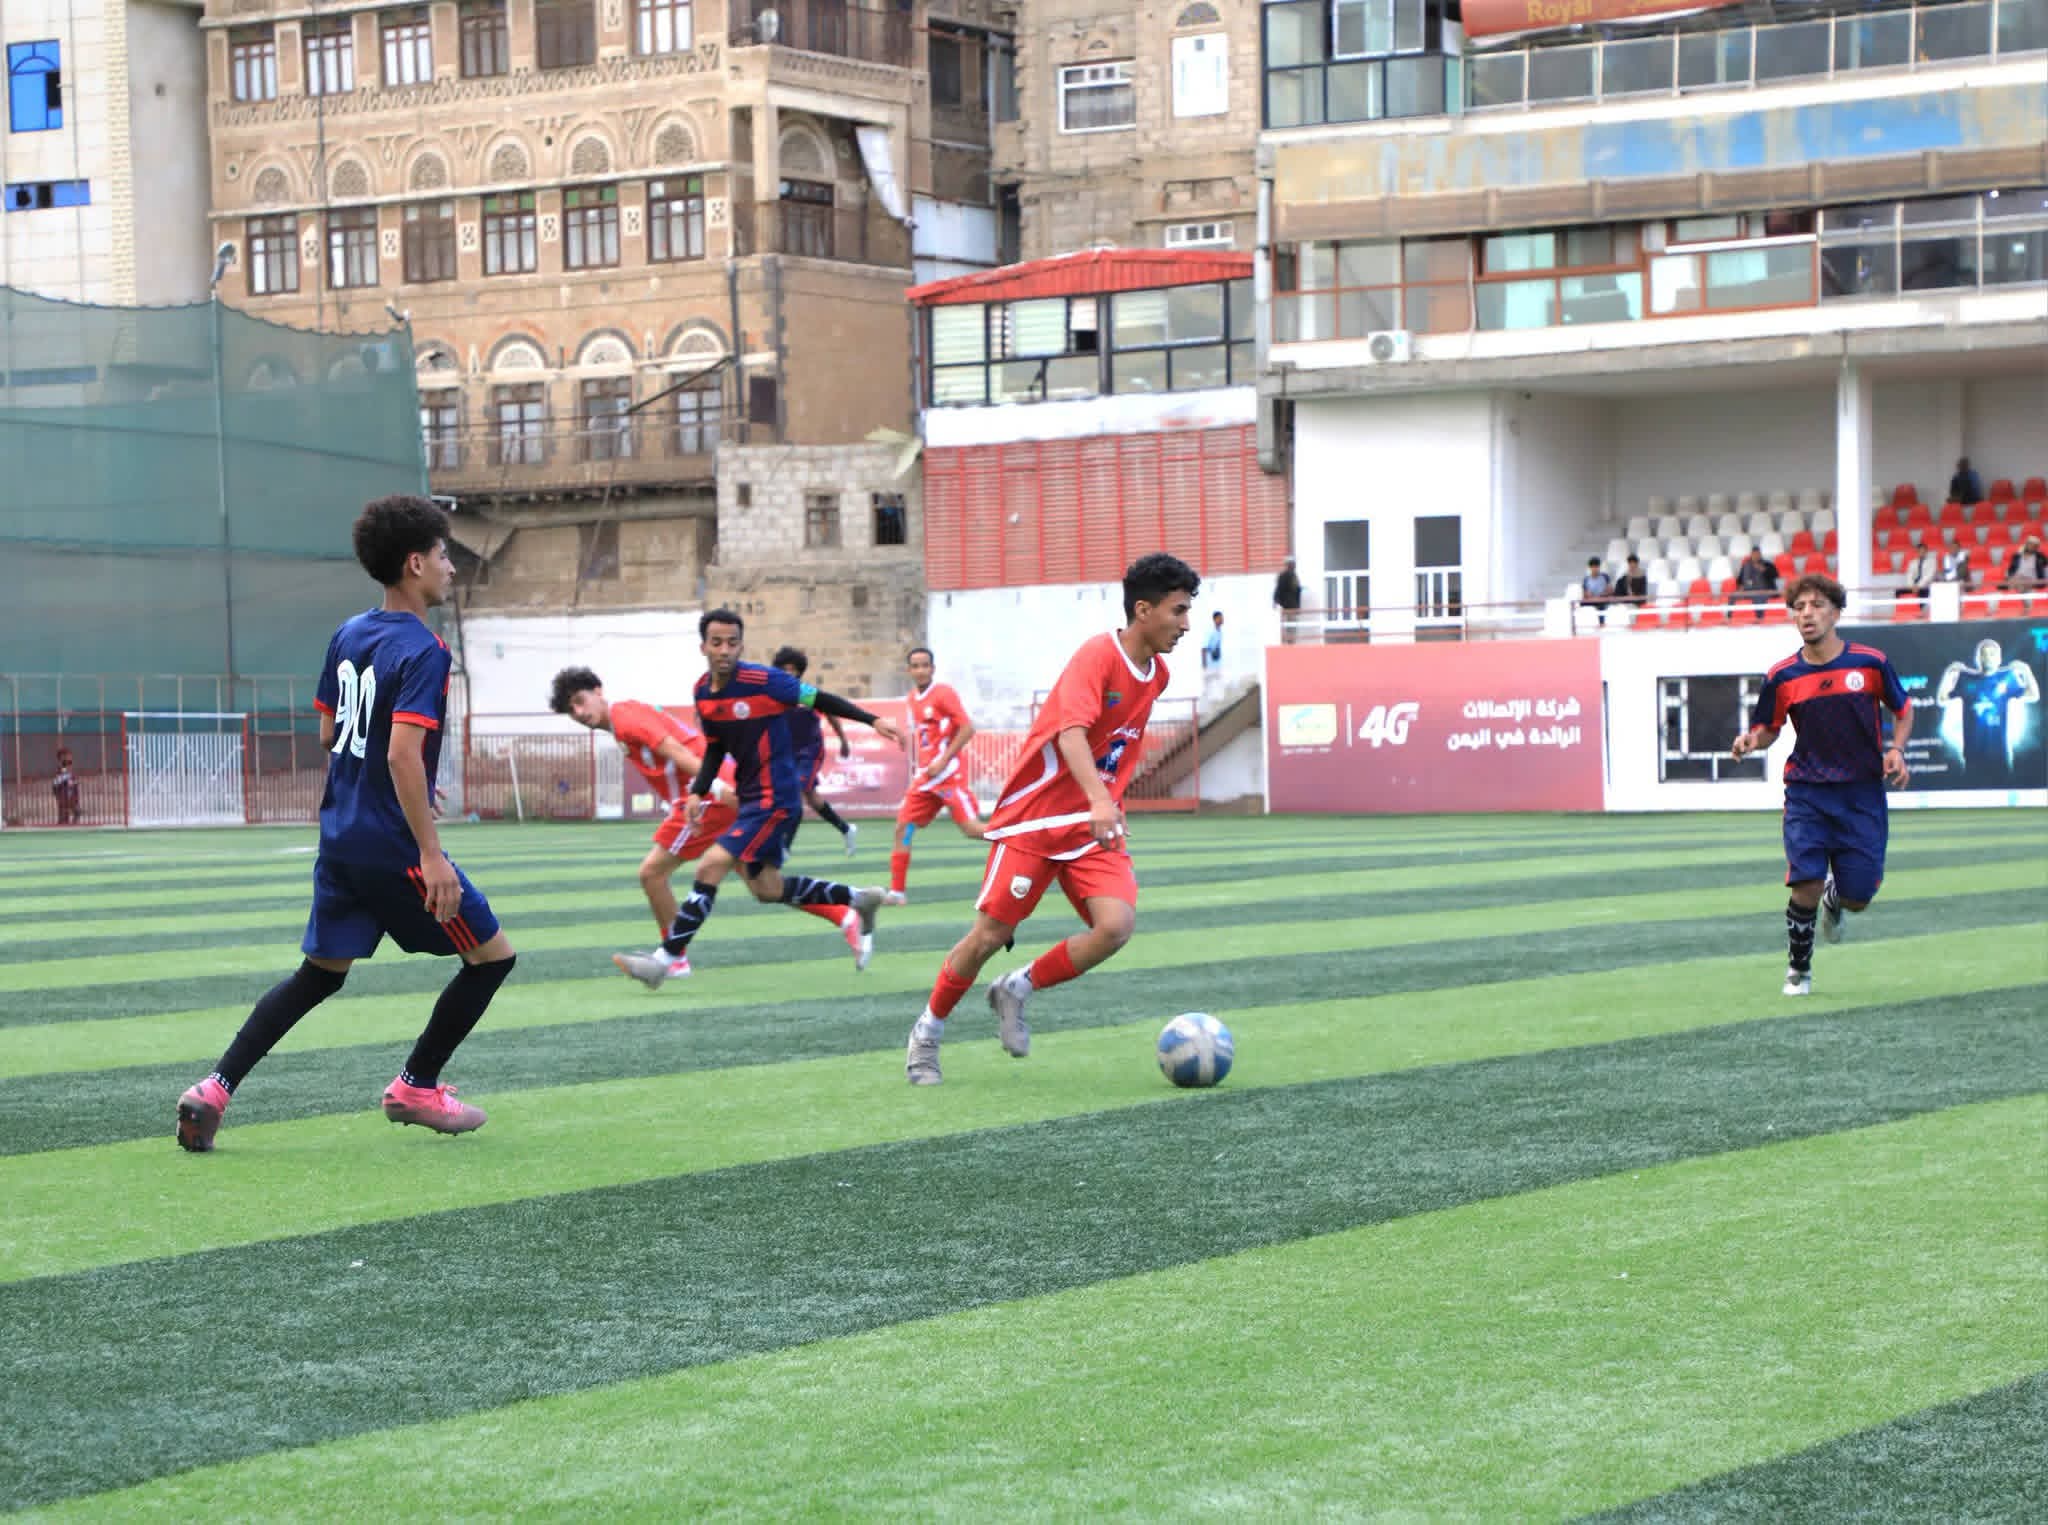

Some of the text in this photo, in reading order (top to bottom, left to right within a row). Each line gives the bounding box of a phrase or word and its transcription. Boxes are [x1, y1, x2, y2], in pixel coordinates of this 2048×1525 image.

[1527, 0, 1592, 22] Royal
[331, 659, 377, 759] 90
[1535, 696, 1581, 721] شركة
[1358, 702, 1420, 748] 4G
[1447, 728, 1492, 752] اليمن
[1494, 728, 1526, 750] في
